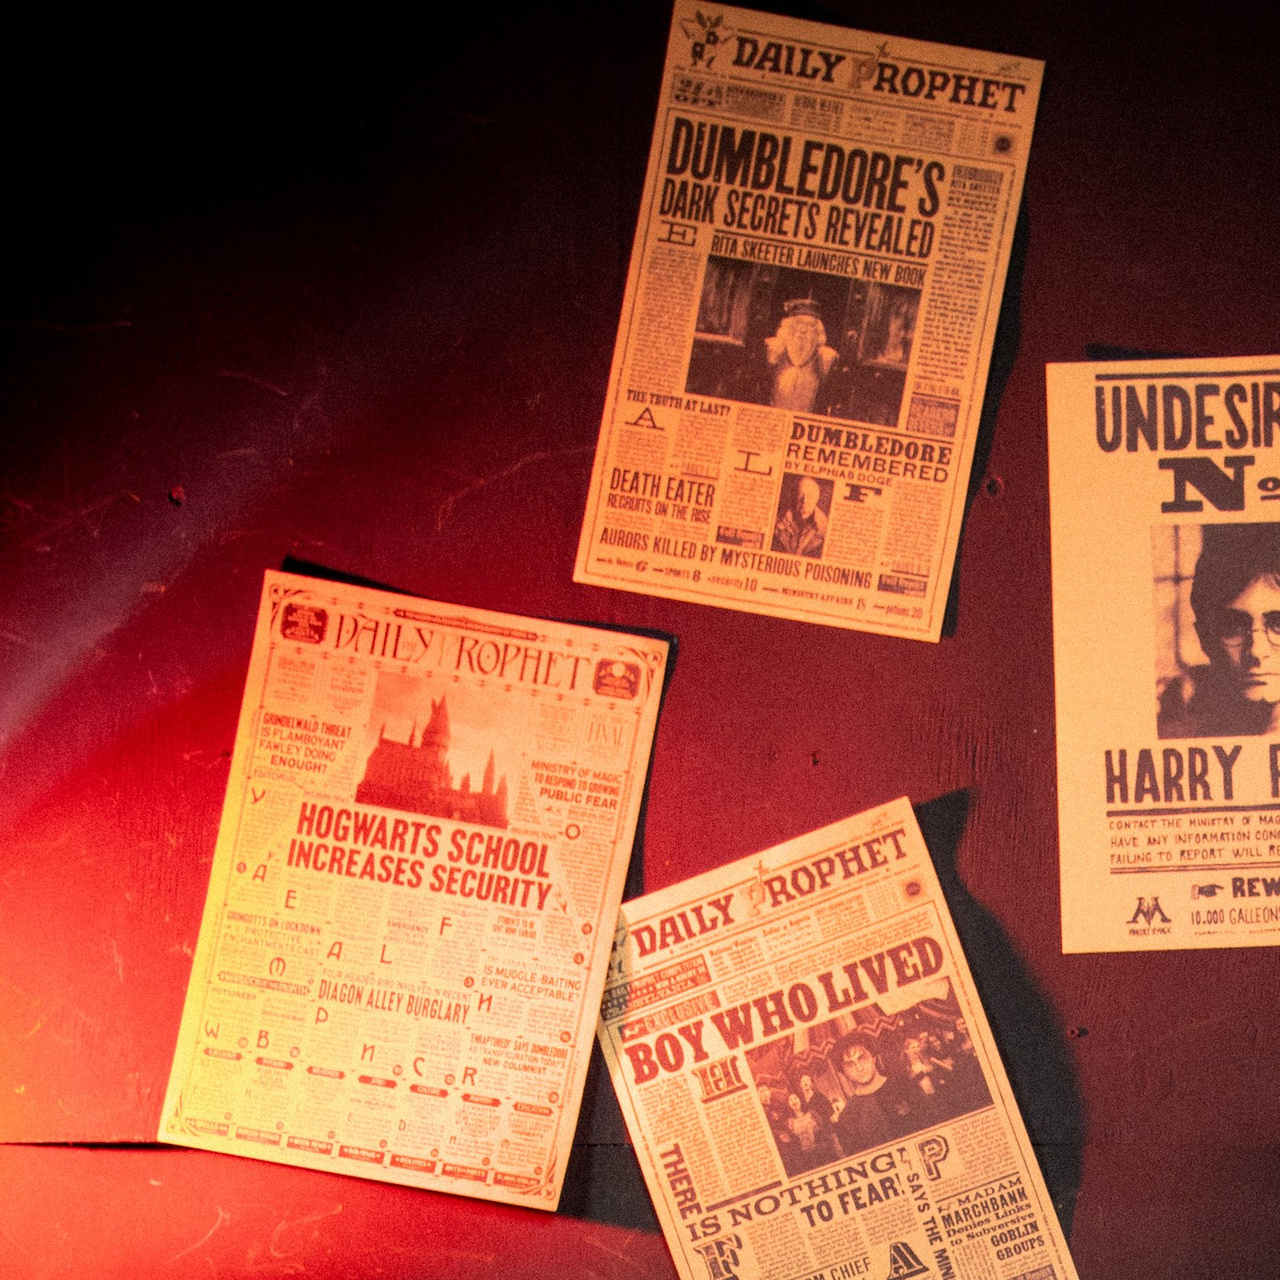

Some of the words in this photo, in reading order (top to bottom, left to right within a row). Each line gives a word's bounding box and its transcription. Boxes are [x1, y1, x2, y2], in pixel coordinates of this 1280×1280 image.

[730, 35, 847, 84] DAILY
[665, 116, 947, 219] DUMBLEDORE'S
[658, 177, 719, 224] DARK
[722, 188, 821, 241] SECRETS
[823, 204, 936, 260] REVEALED
[711, 234, 738, 256] RITA
[740, 239, 795, 265] SKEETER
[797, 249, 860, 276] LAUNCHES
[861, 259, 892, 281] NEW
[894, 264, 926, 286] BOOK
[624, 403, 669, 431] A
[625, 388, 648, 403] THE
[648, 392, 682, 409] TRUTH
[683, 398, 699, 411] AT
[733, 449, 775, 477] L
[786, 442, 949, 484] REMEMBERED
[789, 421, 952, 466] DUMBLEDORE
[609, 467, 662, 499] DEATH
[663, 476, 717, 508] EATER
[784, 460, 800, 471] BY
[802, 463, 855, 480] ELPHIAS
[856, 472, 893, 487] DOGE
[606, 492, 653, 514] RECRUITS
[653, 500, 669, 517] ON
[671, 503, 690, 520] THE
[689, 506, 712, 524] RISE
[842, 481, 883, 506] F
[599, 526, 651, 552] AURORS
[651, 534, 698, 560] KILLED
[699, 542, 718, 563] BY
[719, 546, 802, 578] MYSTERIOUS
[803, 560, 873, 590] POISONING
[333, 610, 435, 665] DAILY
[260, 726, 271, 738] IS
[272, 727, 345, 751] FLAMBOYANT
[320, 721, 351, 739] THREAT
[258, 738, 301, 757] FAWLEY
[303, 746, 337, 763] DOING
[269, 753, 328, 774] ENOUGH?
[530, 759, 577, 777] MINISTRY
[577, 767, 591, 779] OF
[591, 769, 623, 785] MAGIC
[533, 771, 545, 784] TO
[577, 779, 588, 791] TO
[1104, 744, 1243, 805] HARRY
[538, 786, 583, 804] PUBLIC
[584, 794, 618, 810] FEAR
[295, 800, 443, 859] HOGWARTS
[445, 827, 555, 879] SCHOOL
[1109, 819, 1157, 830] CONTACT
[1160, 817, 1182, 828] THE
[1189, 815, 1235, 827] MINISTRY
[1241, 815, 1251, 825] OF
[1110, 835, 1139, 848] HAVE
[1146, 834, 1168, 845] ANY
[1174, 830, 1250, 845] INFORMATION
[286, 837, 426, 890] INCREASES
[426, 861, 553, 912] SECURITY
[1109, 851, 1152, 864] FAILING
[1156, 850, 1172, 862] TO
[1179, 847, 1224, 861] REPORT
[1232, 846, 1262, 858] WILL
[629, 891, 743, 958] DAILY
[480, 976, 508, 990] EVER
[482, 964, 493, 976] IS
[317, 978, 365, 1007] DIAGON
[365, 986, 404, 1014] ALLEY
[404, 993, 470, 1025] BURGLARY
[622, 1018, 716, 1086] BOY
[709, 978, 822, 1054] WHO
[815, 930, 951, 1015] LIVED
[643, 993, 715, 1034] EXCLUSIVE
[912, 1130, 958, 1183] P
[657, 1141, 703, 1220] THERE
[685, 1214, 723, 1243] IS
[726, 1150, 896, 1228] NOTHING
[955, 1175, 1023, 1207] MADAM
[799, 1198, 835, 1229] TO
[836, 1172, 905, 1216] FEAR!
[905, 1171, 931, 1214] SAYS
[921, 1215, 943, 1246] THE
[940, 1185, 1029, 1230] MARCHBANK
[945, 1215, 991, 1238] Denies
[993, 1200, 1032, 1221] Links
[949, 1236, 963, 1248] to
[965, 1209, 1035, 1242] Subversive
[989, 1219, 1041, 1248] GOBLIN
[994, 1234, 1045, 1262] GROUPS
